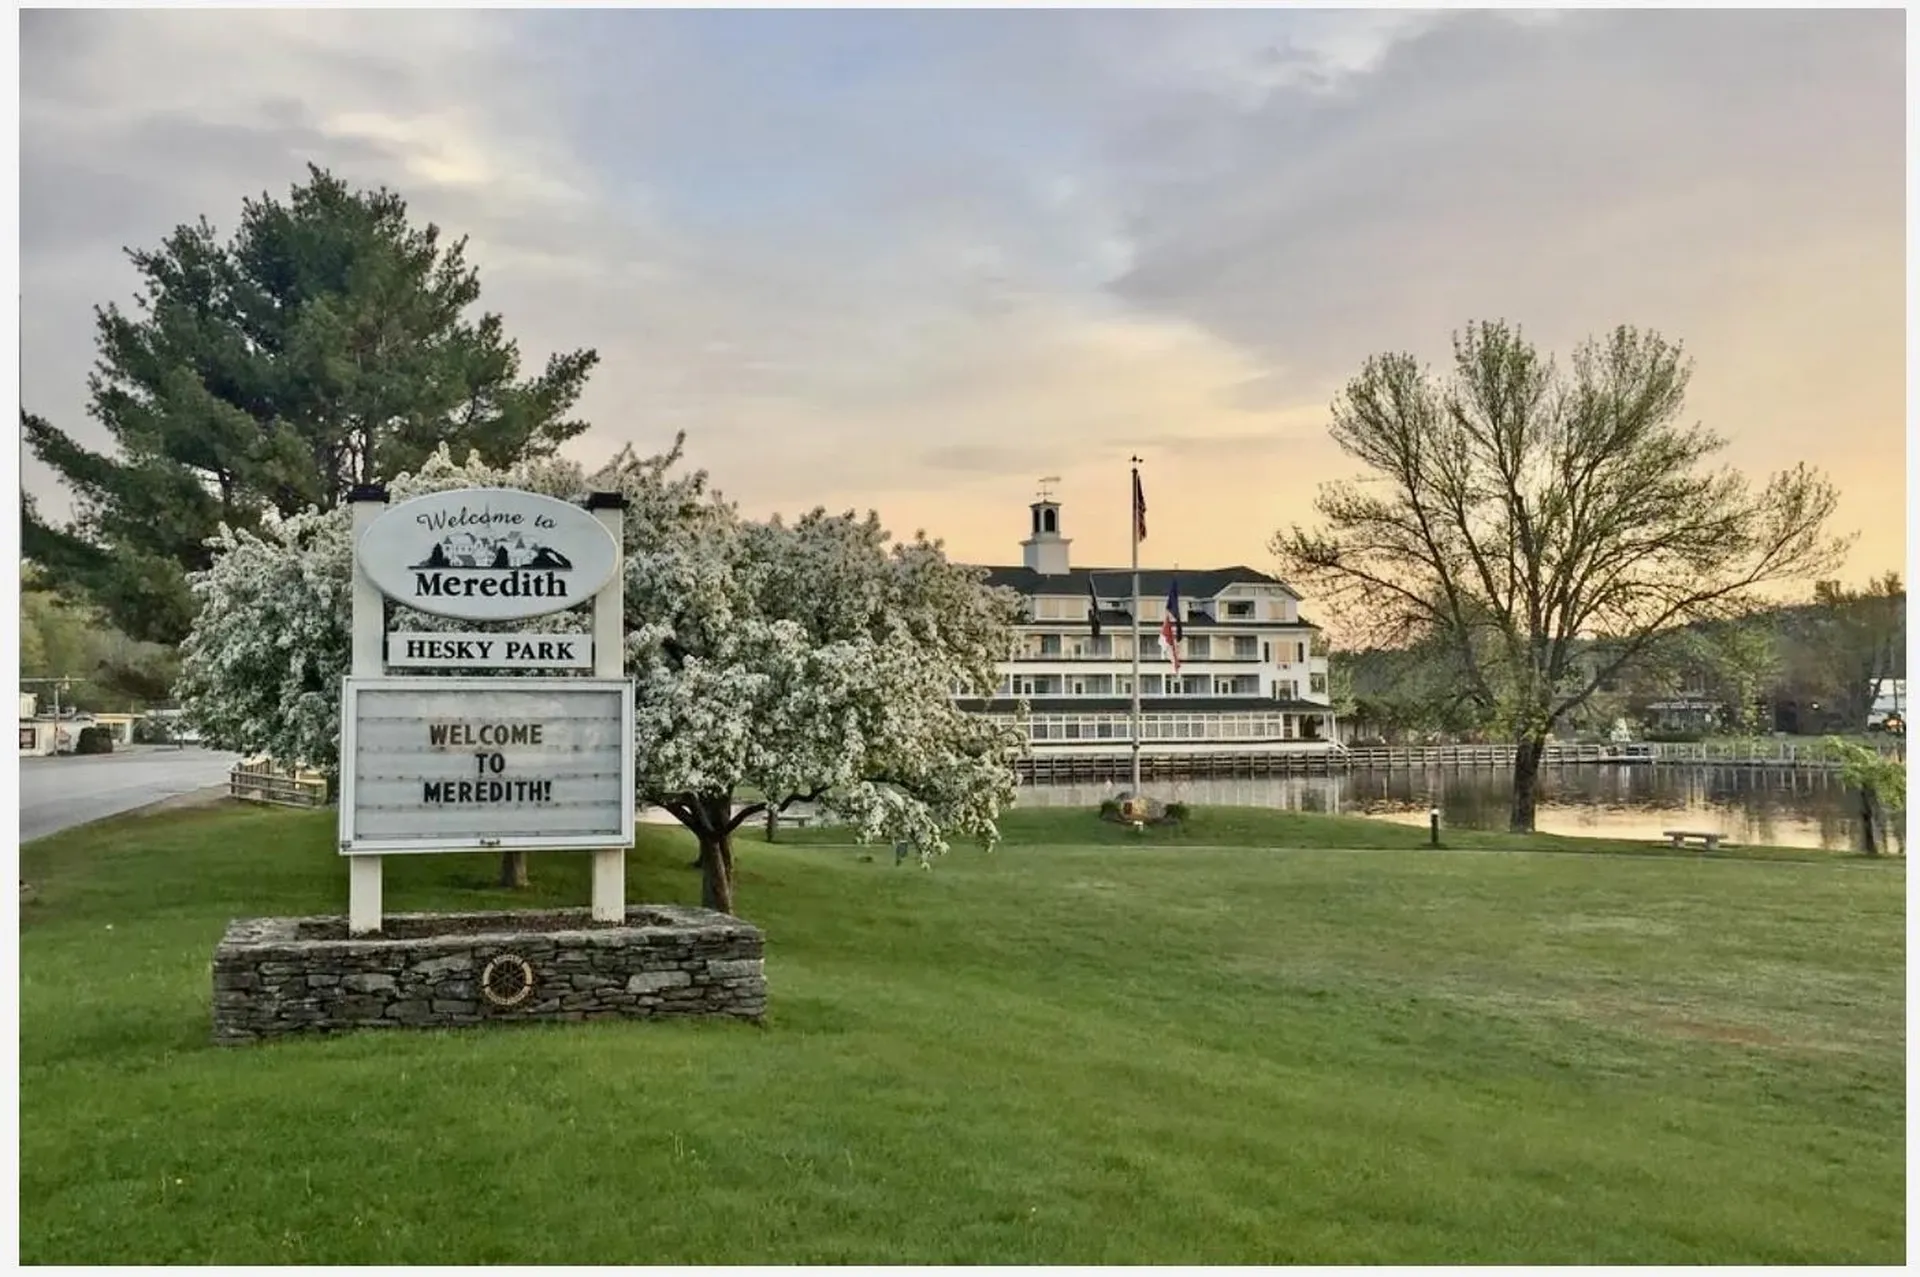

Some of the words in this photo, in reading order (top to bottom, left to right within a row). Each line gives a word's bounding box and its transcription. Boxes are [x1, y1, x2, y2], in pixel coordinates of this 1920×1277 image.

[416, 506, 524, 531] Welcome
[534, 513, 557, 530] to
[415, 571, 568, 597] Meredith
[406, 640, 493, 660] HESKY
[505, 641, 575, 660] PARK
[429, 724, 543, 746] WELCOME
[475, 753, 506, 774] TO
[423, 781, 552, 803] MEREDITH!
